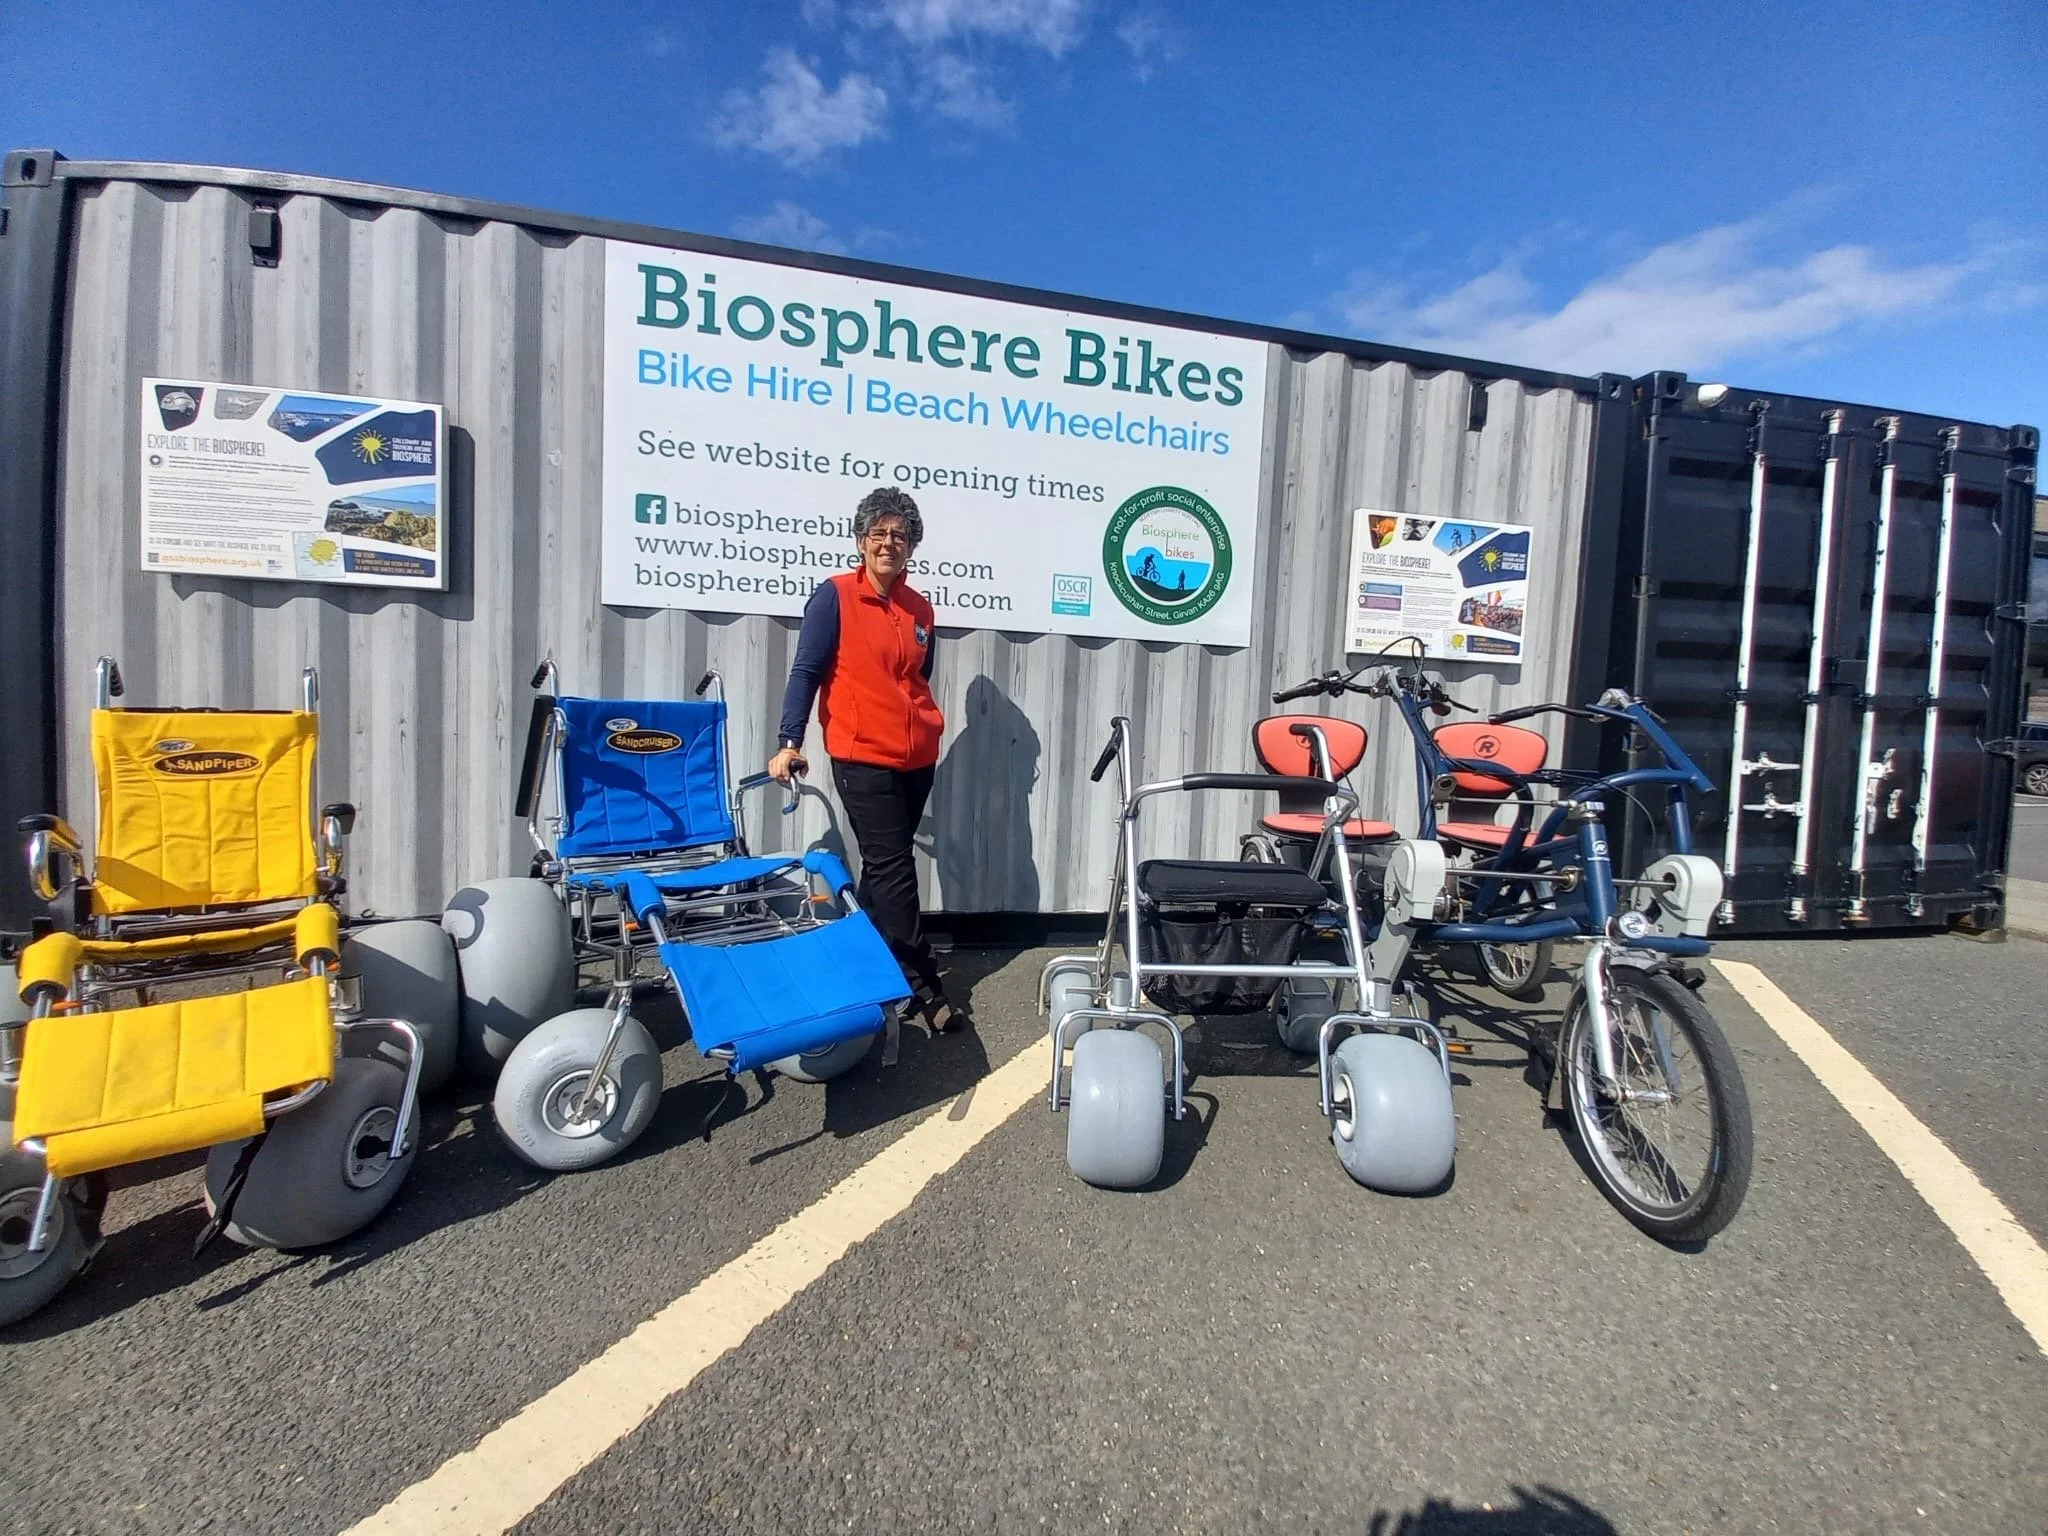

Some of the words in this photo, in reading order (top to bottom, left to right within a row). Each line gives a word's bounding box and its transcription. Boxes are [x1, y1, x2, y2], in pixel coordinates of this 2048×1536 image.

[636, 263, 1041, 378] Biosphere
[1063, 328, 1244, 406] Bikes
[638, 349, 732, 393] Bike
[747, 363, 833, 405] Hire
[865, 379, 989, 426] Beach
[1001, 396, 1230, 456] Wheelchairs
[147, 433, 189, 451] EXPLORE
[192, 437, 211, 453] THE
[213, 438, 265, 457] BIOSPHERE!
[637, 430, 695, 460] See
[706, 441, 830, 474] website
[840, 452, 885, 480] for
[893, 463, 1019, 499] opening
[1028, 473, 1105, 503] times
[1113, 491, 1166, 535] not-for-profit
[1167, 493, 1196, 509] social
[674, 502, 857, 539] biospherebik
[1142, 524, 1200, 541] Biosphere
[1195, 504, 1226, 550] enterprise
[1110, 535, 1119, 543] a
[1165, 546, 1195, 560] bikes
[1057, 579, 1087, 594] OSCR
[1109, 561, 1144, 612] Knockcushan
[1172, 606, 1199, 619] Girvan
[1197, 589, 1216, 609] KA26
[1213, 572, 1225, 592] 9AG
[615, 735, 674, 748] SANDCRUISER
[176, 757, 253, 771] SANDPIPER
